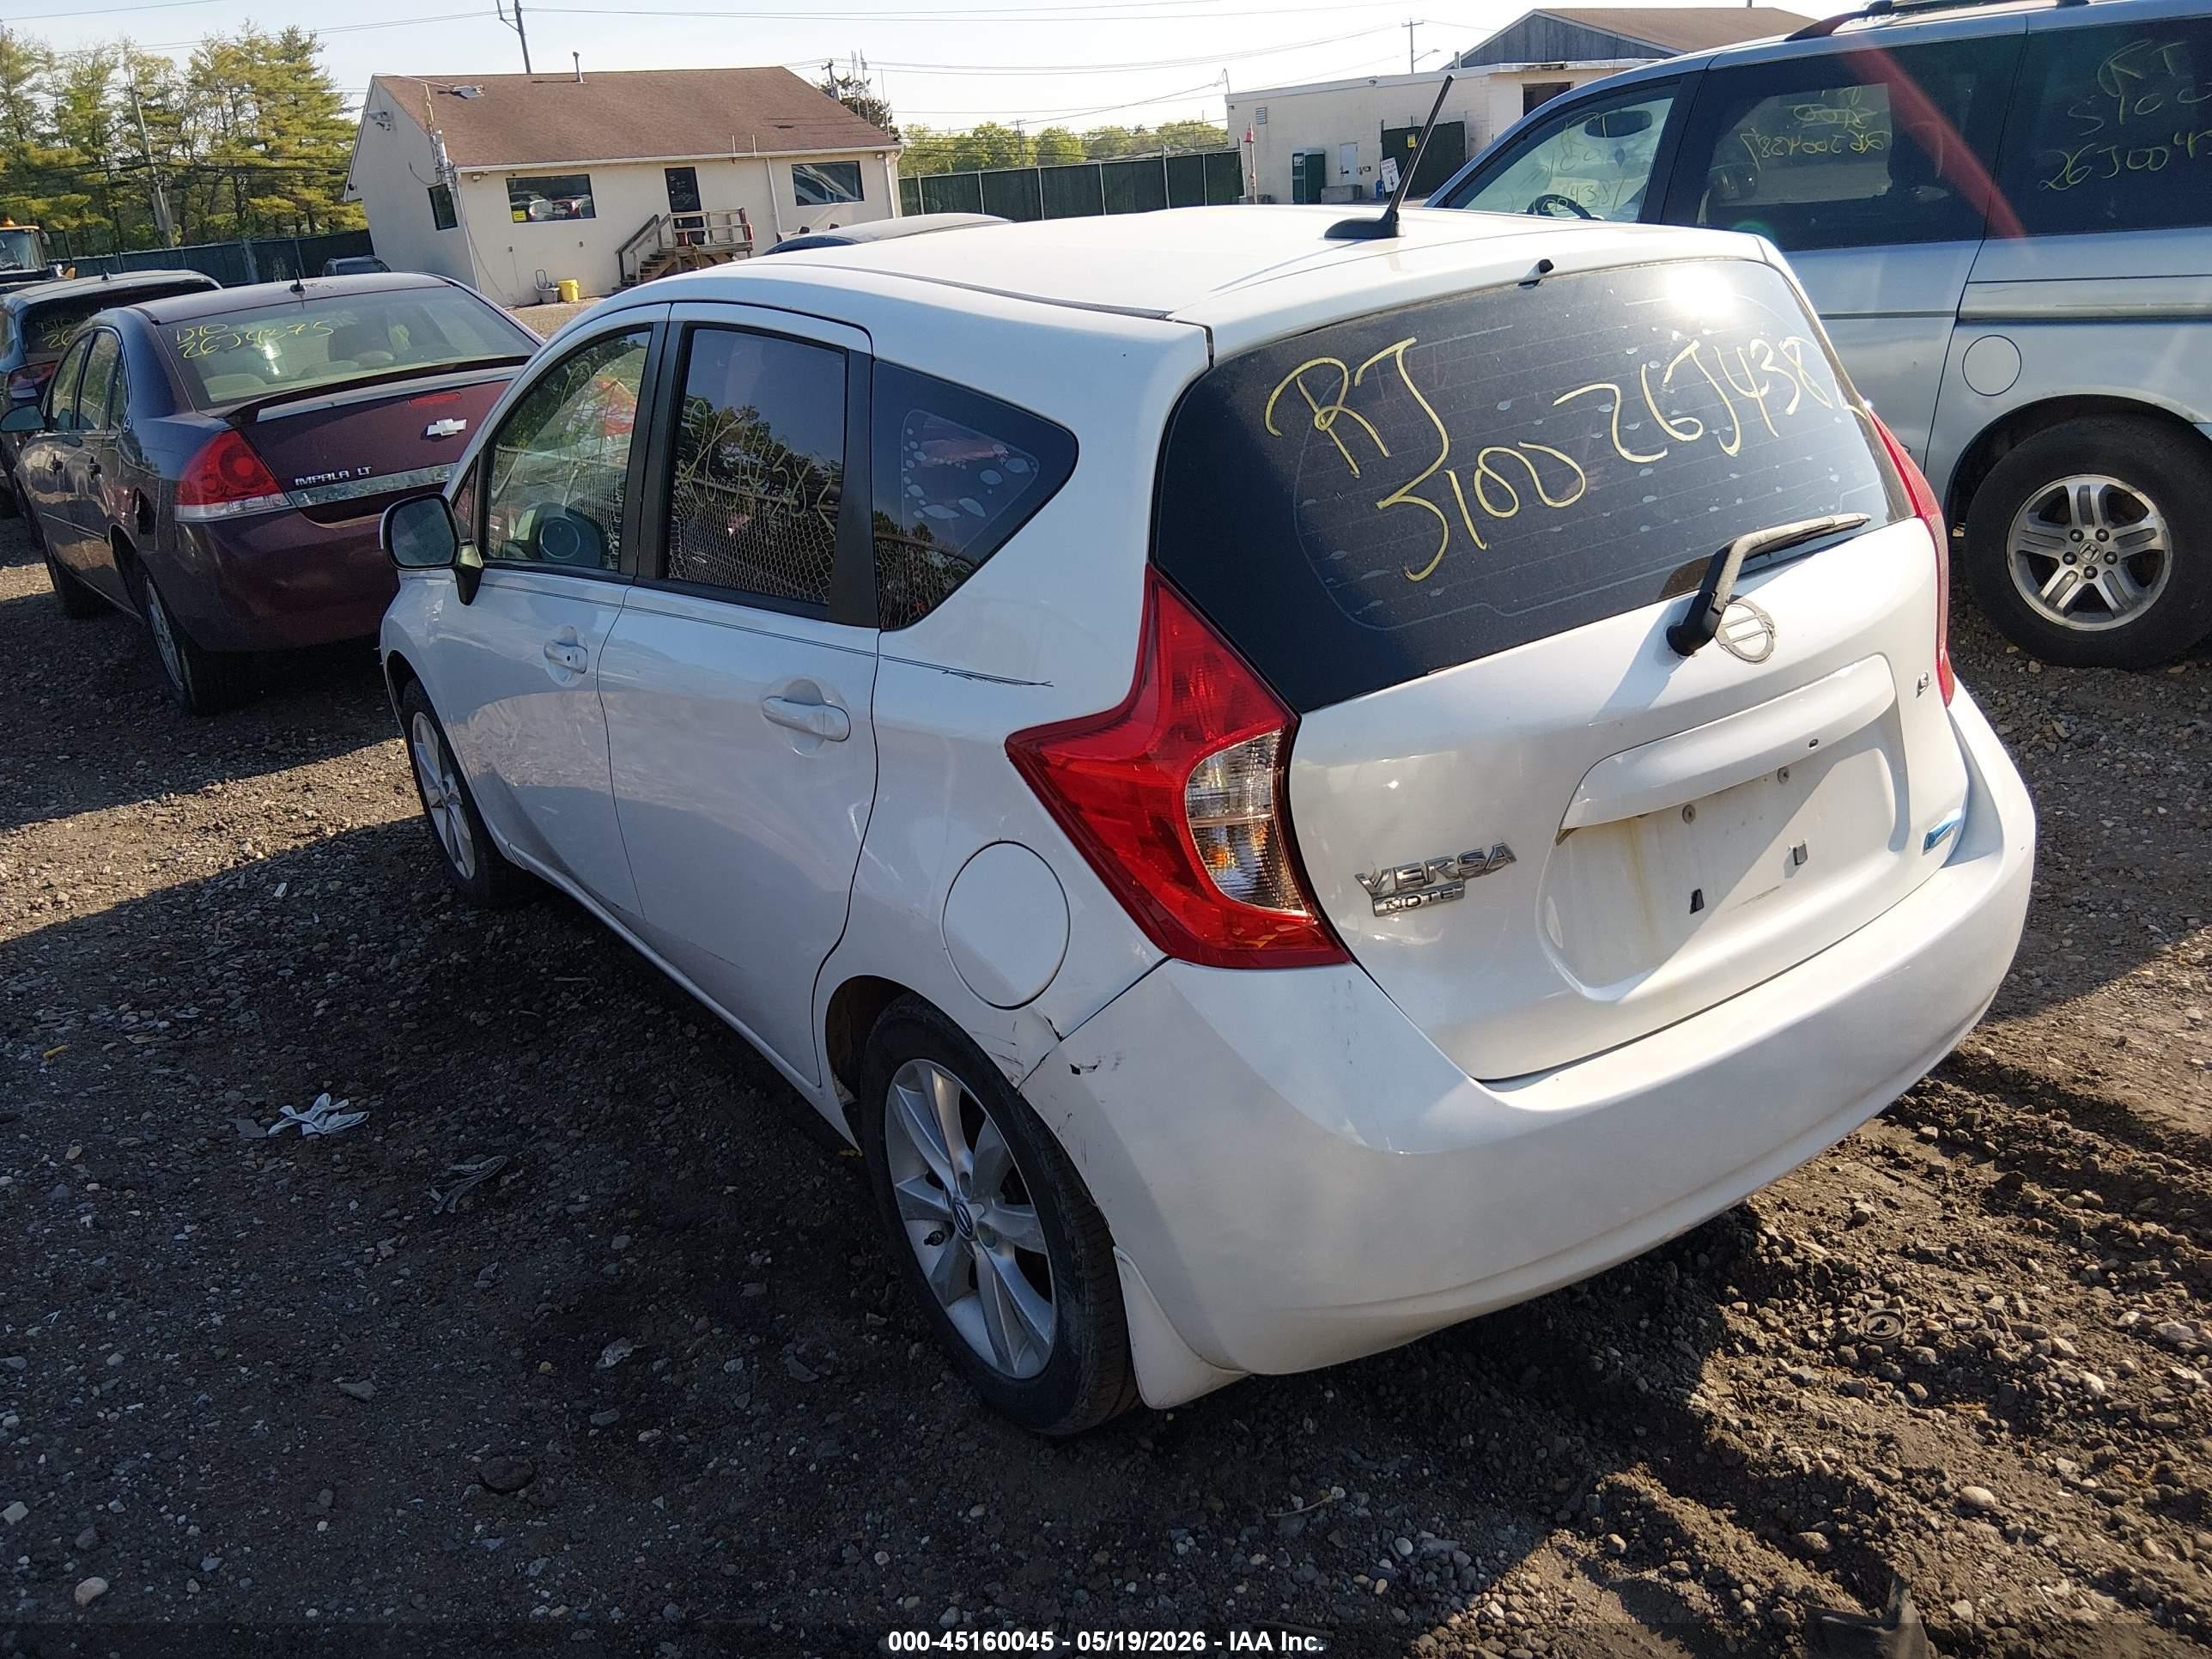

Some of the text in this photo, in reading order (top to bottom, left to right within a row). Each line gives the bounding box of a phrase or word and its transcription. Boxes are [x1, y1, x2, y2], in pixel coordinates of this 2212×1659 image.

[295, 466, 373, 486] IMPALA LT
[1354, 842, 1517, 898] VERSA
[1385, 888, 1457, 912] NOTE
